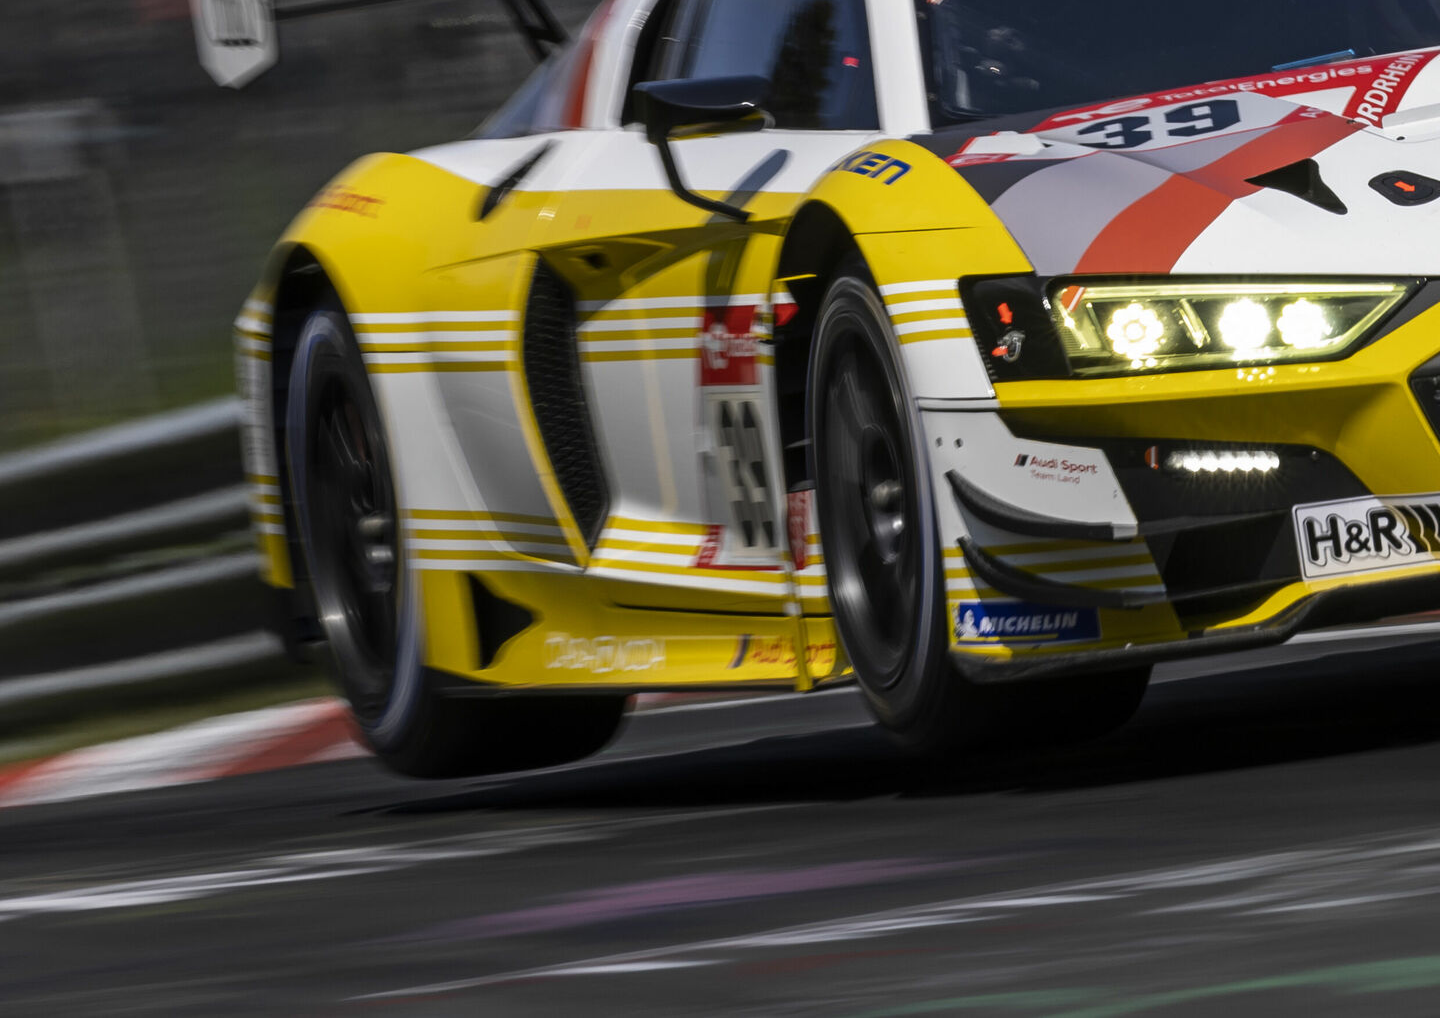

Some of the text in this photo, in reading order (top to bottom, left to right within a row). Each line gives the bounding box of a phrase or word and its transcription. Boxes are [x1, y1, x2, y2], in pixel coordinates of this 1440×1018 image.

[1077, 99, 1242, 149] 39
[1030, 456, 1098, 474] Audi Sport
[1304, 507, 1408, 564] H&R
[979, 611, 1078, 634] MICHELIN
